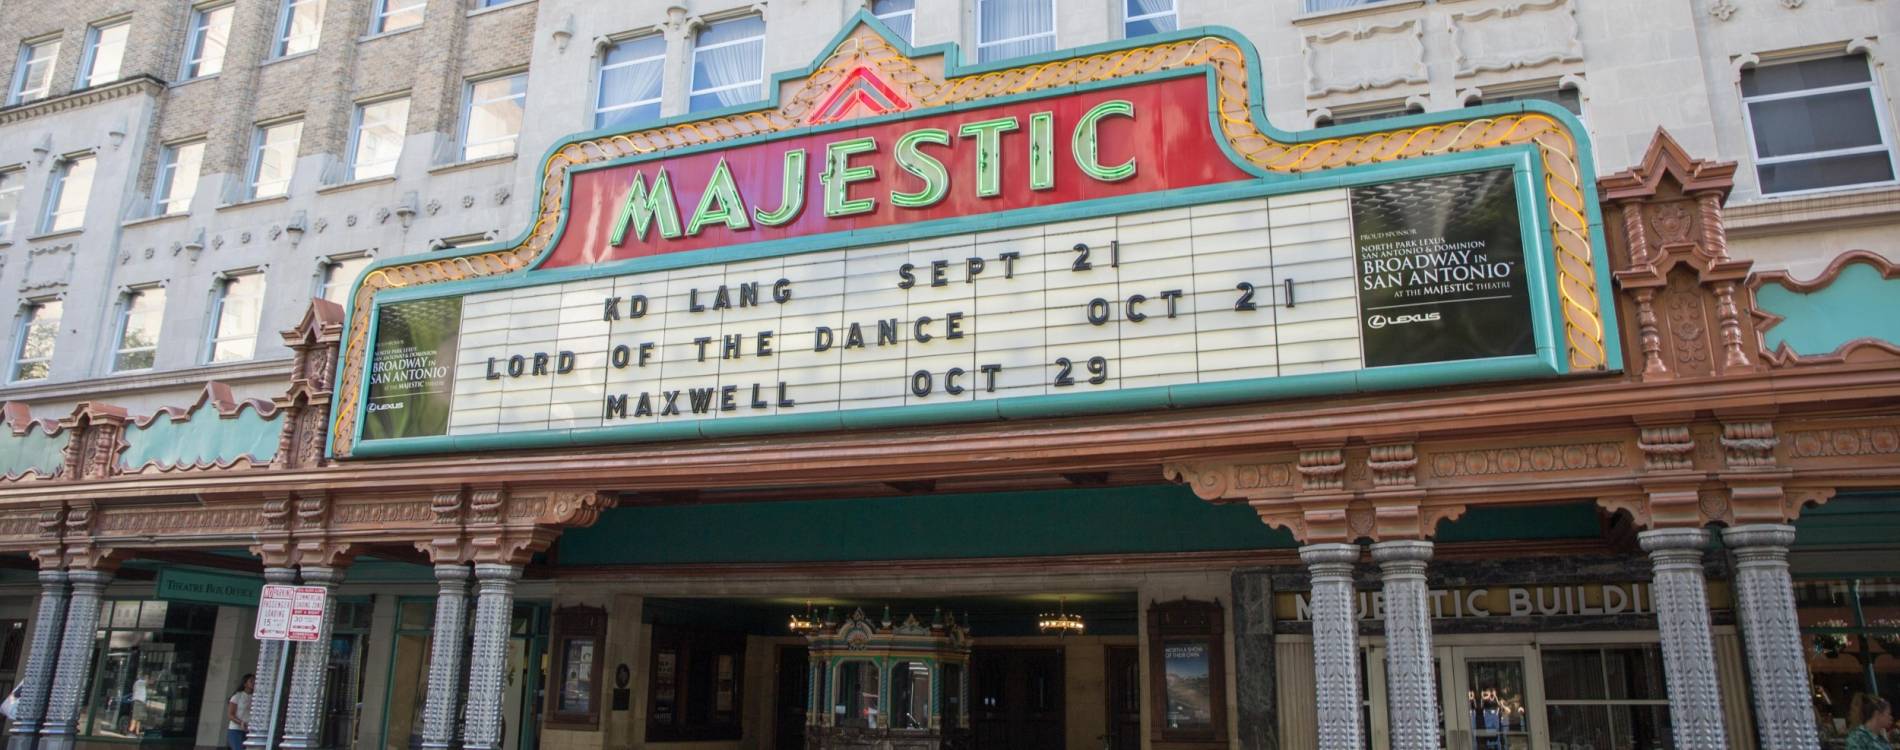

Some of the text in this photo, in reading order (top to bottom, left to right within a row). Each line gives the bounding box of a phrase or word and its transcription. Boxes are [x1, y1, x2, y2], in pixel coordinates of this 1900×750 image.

[609, 99, 1137, 248] MAJESTIC
[1360, 232, 1385, 241] PROUD
[1361, 237, 1445, 253] NORTH PARK LEXUS
[1362, 240, 1486, 260] SAN ANTONIO & DOMINION
[1364, 250, 1488, 275] BROADWAY IN
[603, 240, 1120, 322] KD LANG SEPT 21
[1364, 272, 1402, 291] SAN
[1394, 281, 1511, 298] AT THE MAJESTIC THEATRE
[1387, 312, 1441, 325] LEXUS
[486, 278, 1295, 380] LORD OF THE DANCE OCT 21
[372, 356, 436, 373] BROADWAY IN
[370, 372, 393, 385] SAN
[398, 380, 424, 389] MAJESTIC
[605, 356, 1108, 419] MAXWELL OCT 29
[376, 402, 404, 411] LEXUS
[1295, 583, 1658, 621] MJETIC BUILDI
